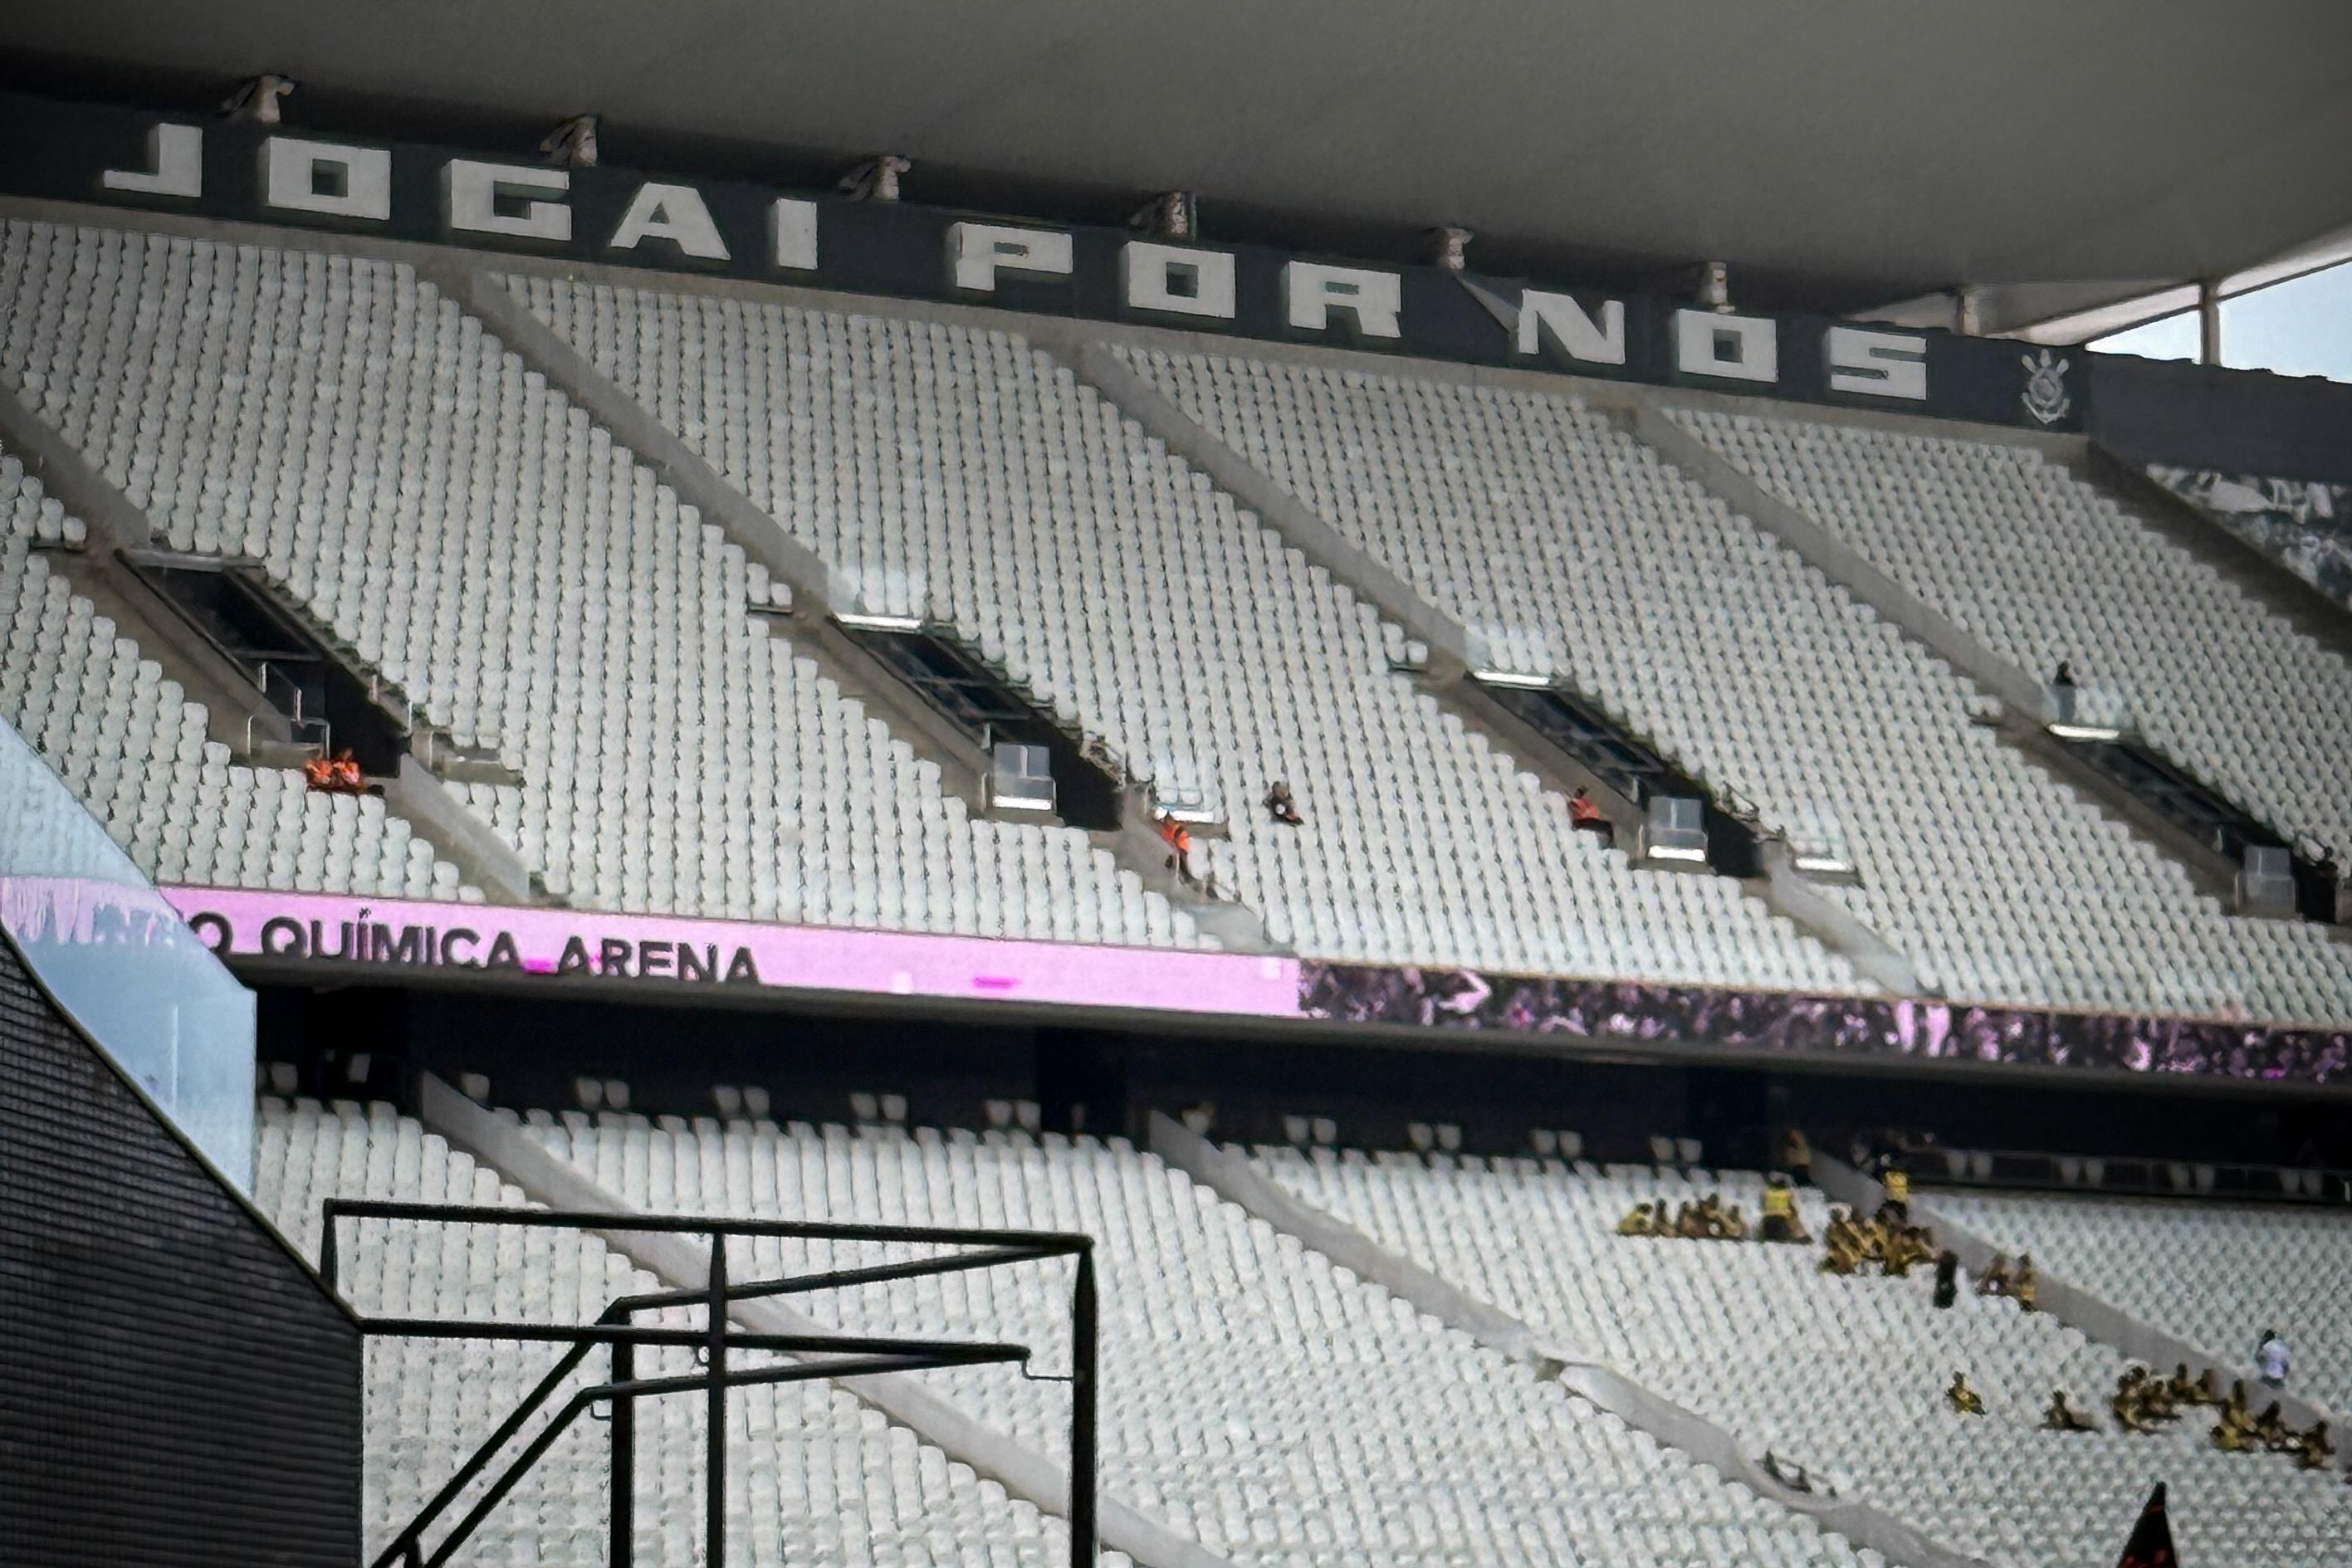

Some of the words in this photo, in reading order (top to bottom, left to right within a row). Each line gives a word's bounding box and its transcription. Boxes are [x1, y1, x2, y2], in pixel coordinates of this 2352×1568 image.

[102, 123, 819, 271] JOGAI
[951, 221, 1401, 339] POR
[557, 935, 760, 985] ARENA
